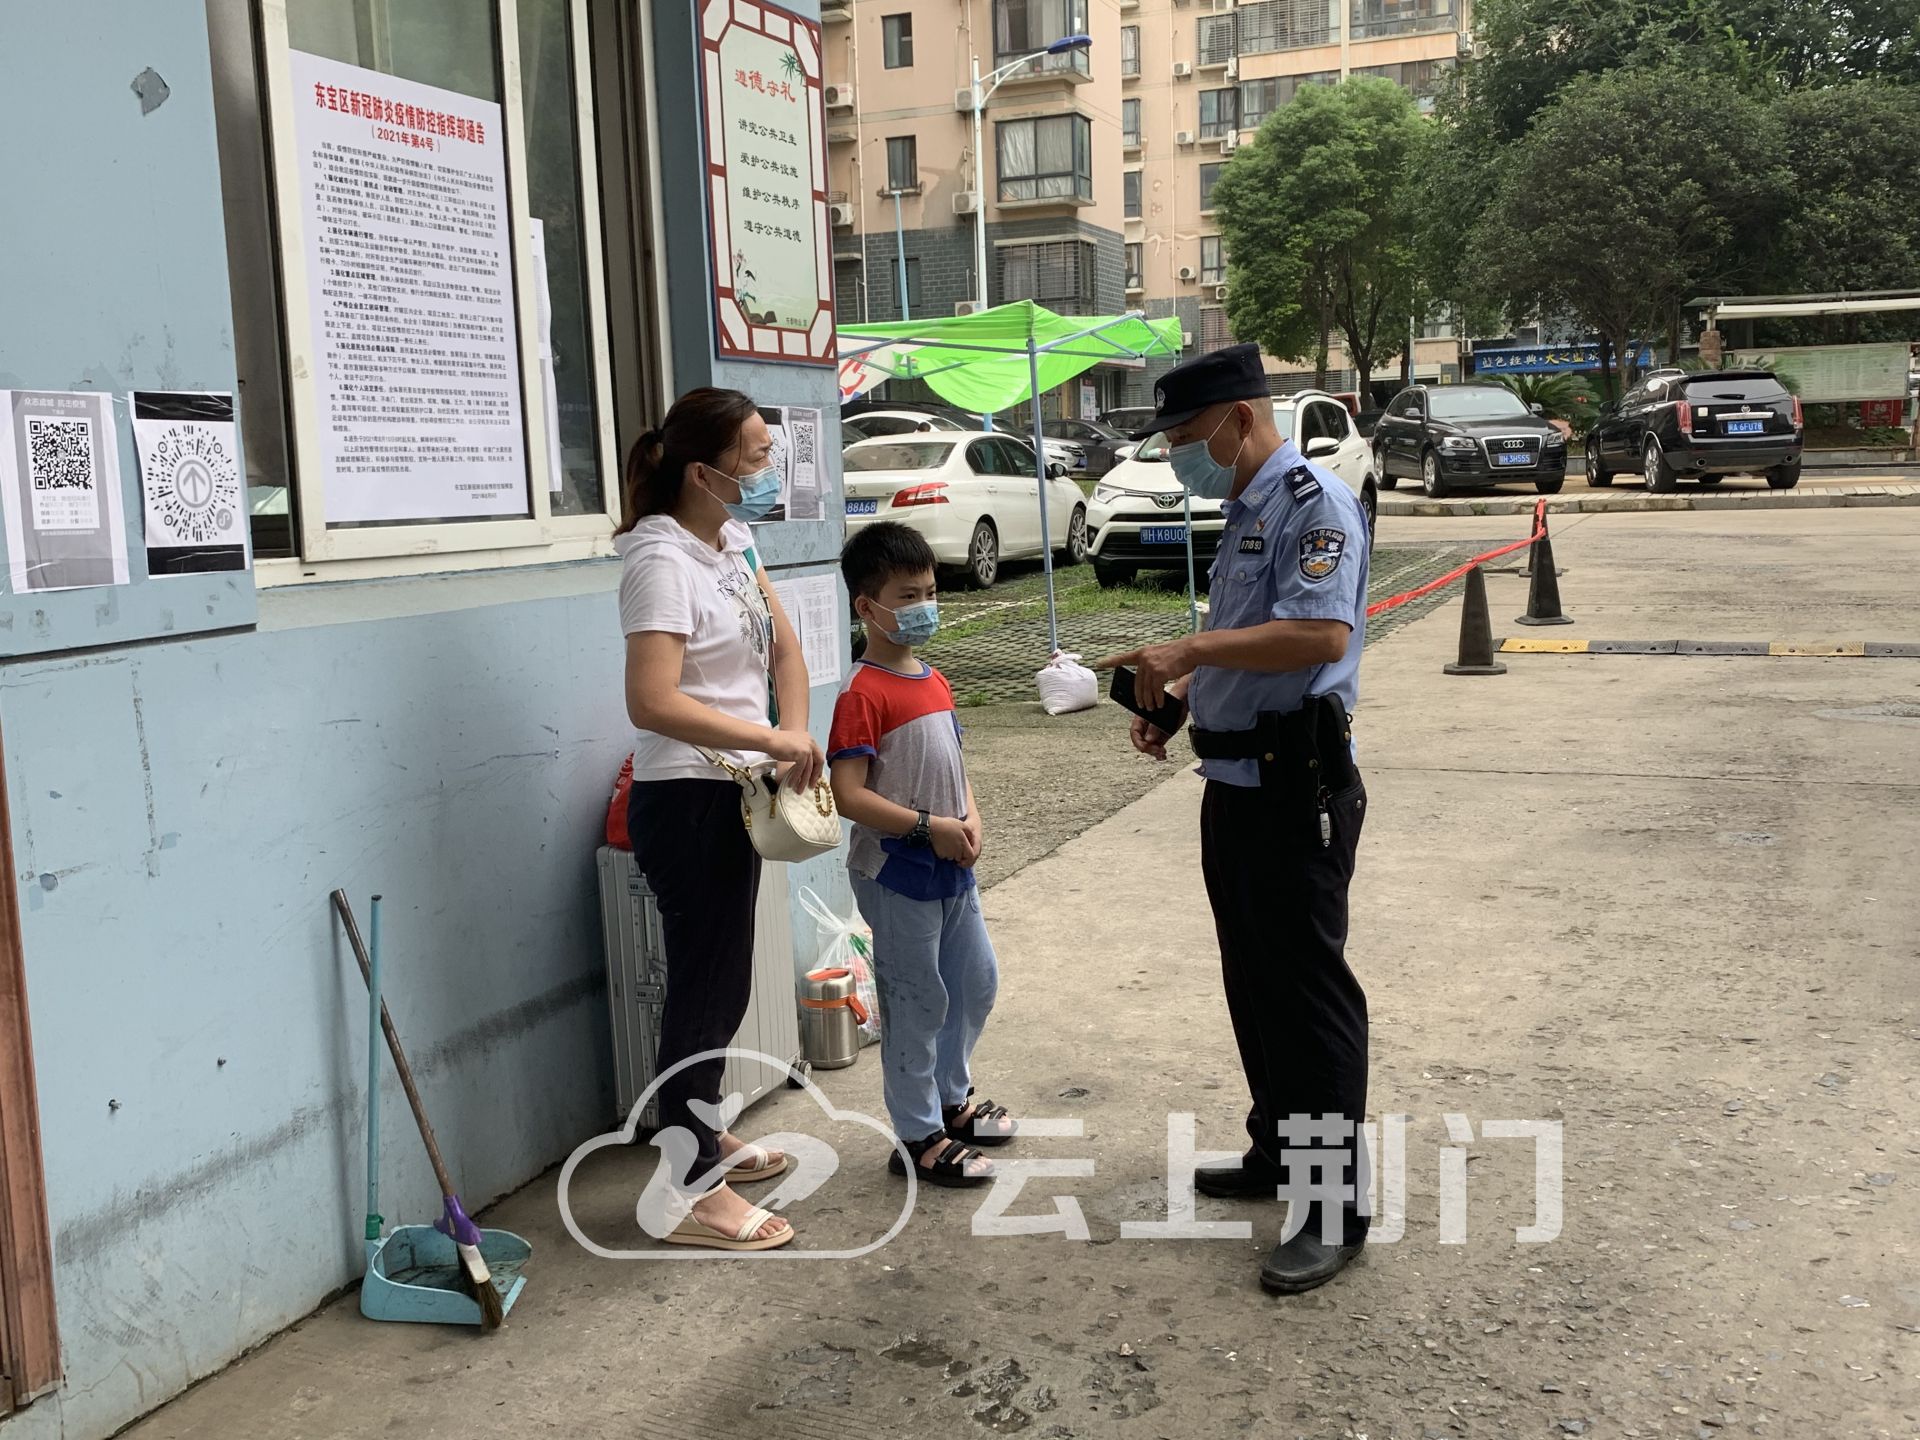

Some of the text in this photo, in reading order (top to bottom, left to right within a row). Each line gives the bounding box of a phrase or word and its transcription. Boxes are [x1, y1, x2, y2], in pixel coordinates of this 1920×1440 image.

[314, 81, 486, 145] 东宝区新冠肺炎疫情防控指挥部通告
[738, 118, 797, 146] 讲究公共卫生
[740, 152, 799, 178] 爱护公共设施
[742, 186, 800, 210] 维护公共秩序
[743, 219, 801, 243] 遵守公共道德
[847, 501, 877, 513] 88A68
